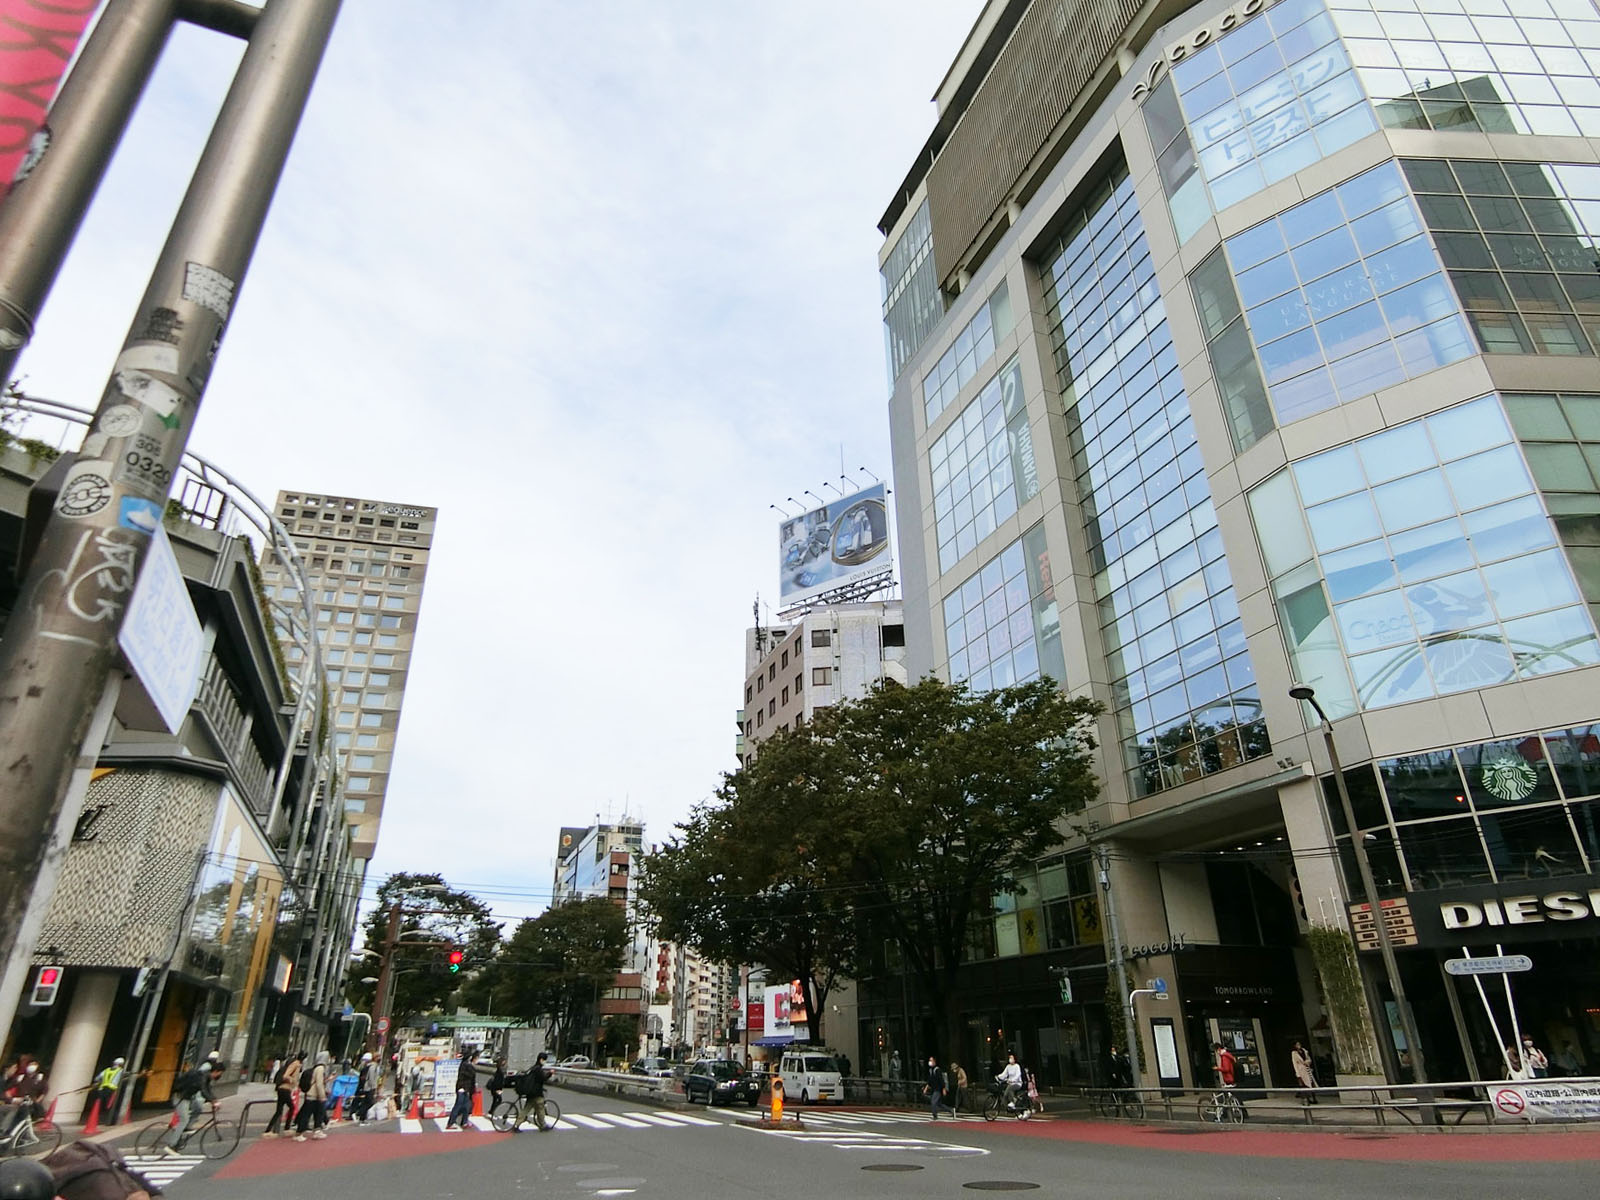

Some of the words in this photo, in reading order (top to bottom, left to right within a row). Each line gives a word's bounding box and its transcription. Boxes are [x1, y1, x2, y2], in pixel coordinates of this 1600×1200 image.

[1203, 57, 1335, 142] ヒューマン
[1223, 92, 1332, 160] トラスト
[1018, 421, 1038, 484] YAMAHA
[1214, 985, 1274, 995] TOMORROWLAND
